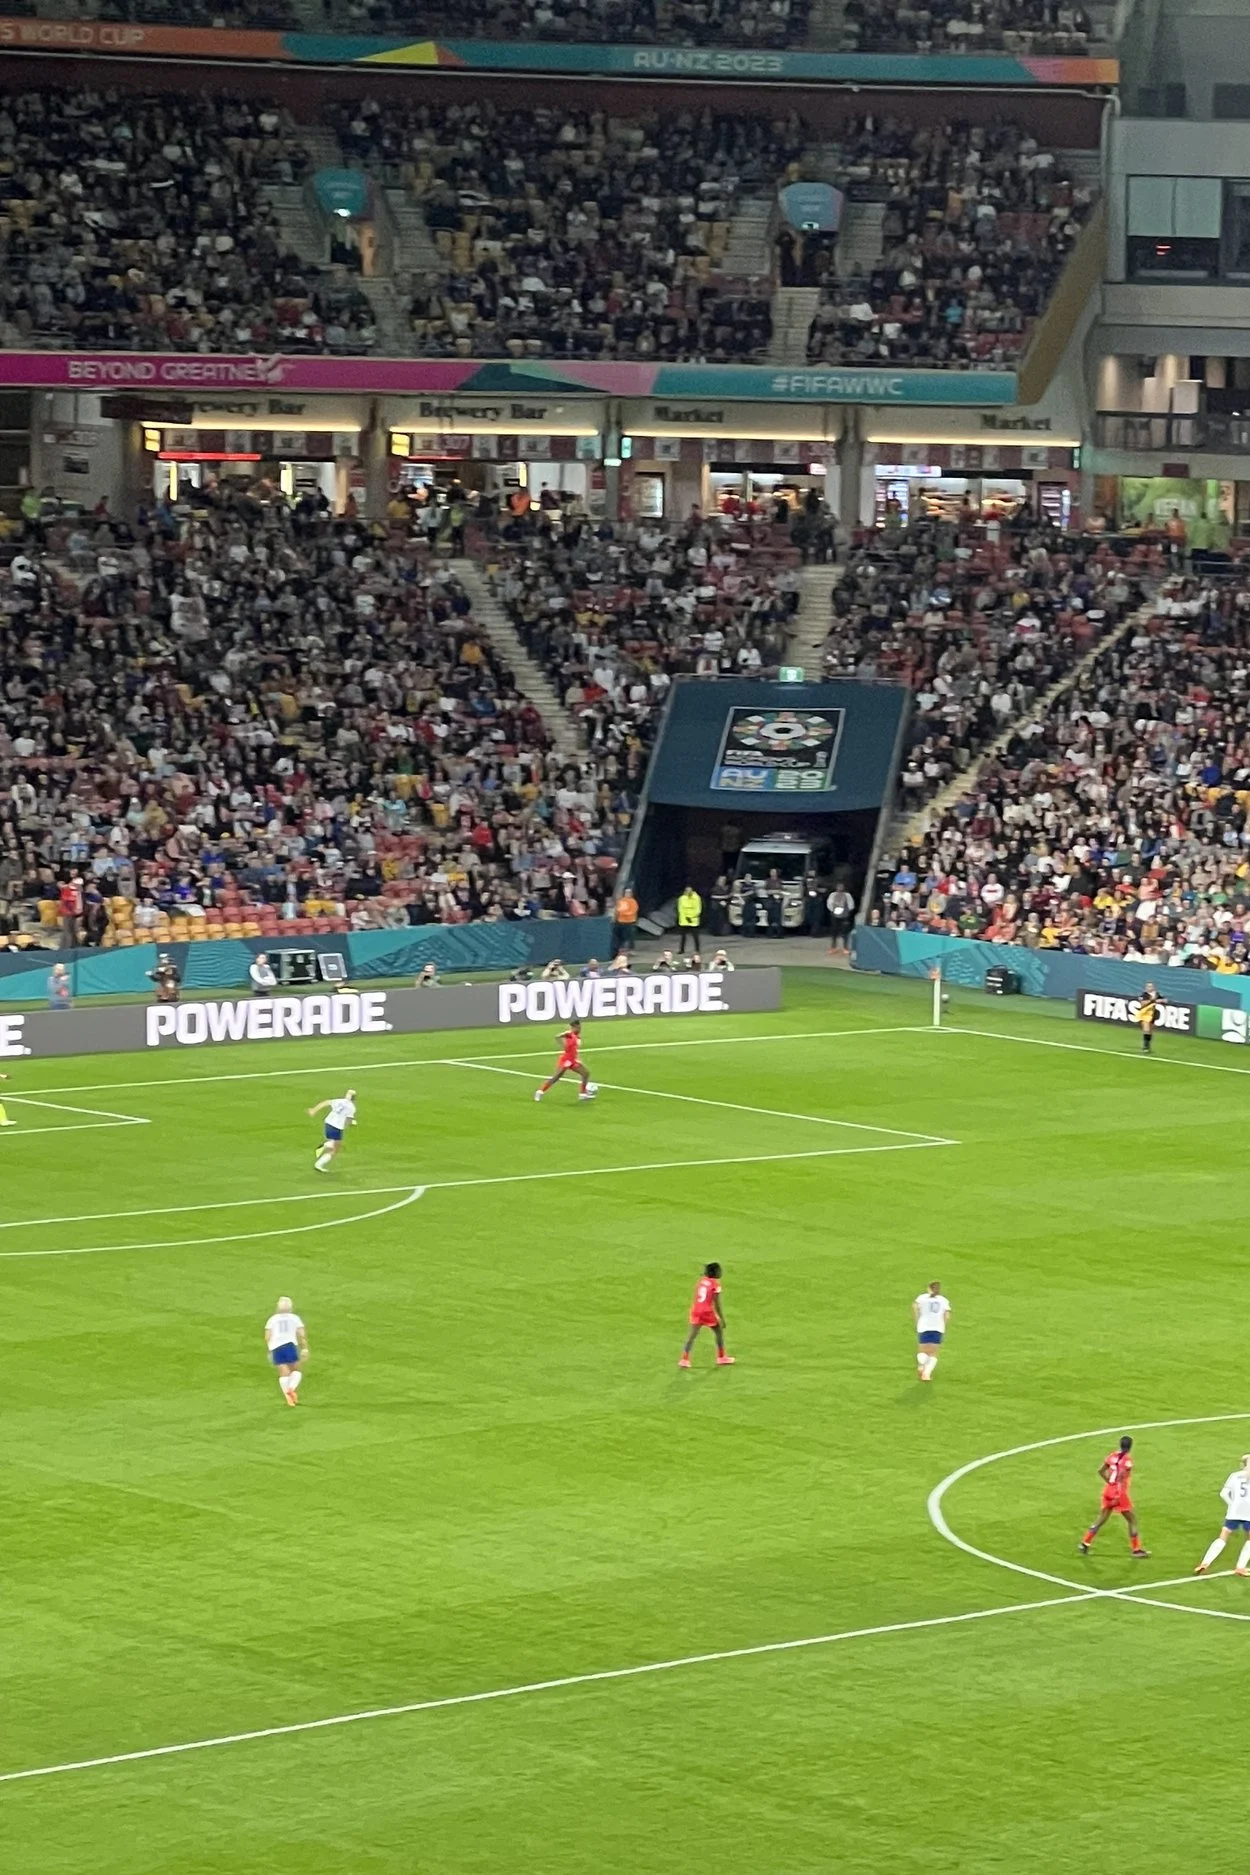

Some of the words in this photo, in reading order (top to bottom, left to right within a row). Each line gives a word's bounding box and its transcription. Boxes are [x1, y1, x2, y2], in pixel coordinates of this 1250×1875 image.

[21, 24, 94, 44] WORLD
[99, 28, 145, 45] CUP
[68, 360, 156, 380] BEYOND
[771, 375, 904, 395] #FIFAWWC
[721, 768, 769, 779] AU
[498, 972, 725, 1024] POWERADE
[146, 991, 389, 1047] POWERADE
[1240, 1481, 1249, 1498] 5
